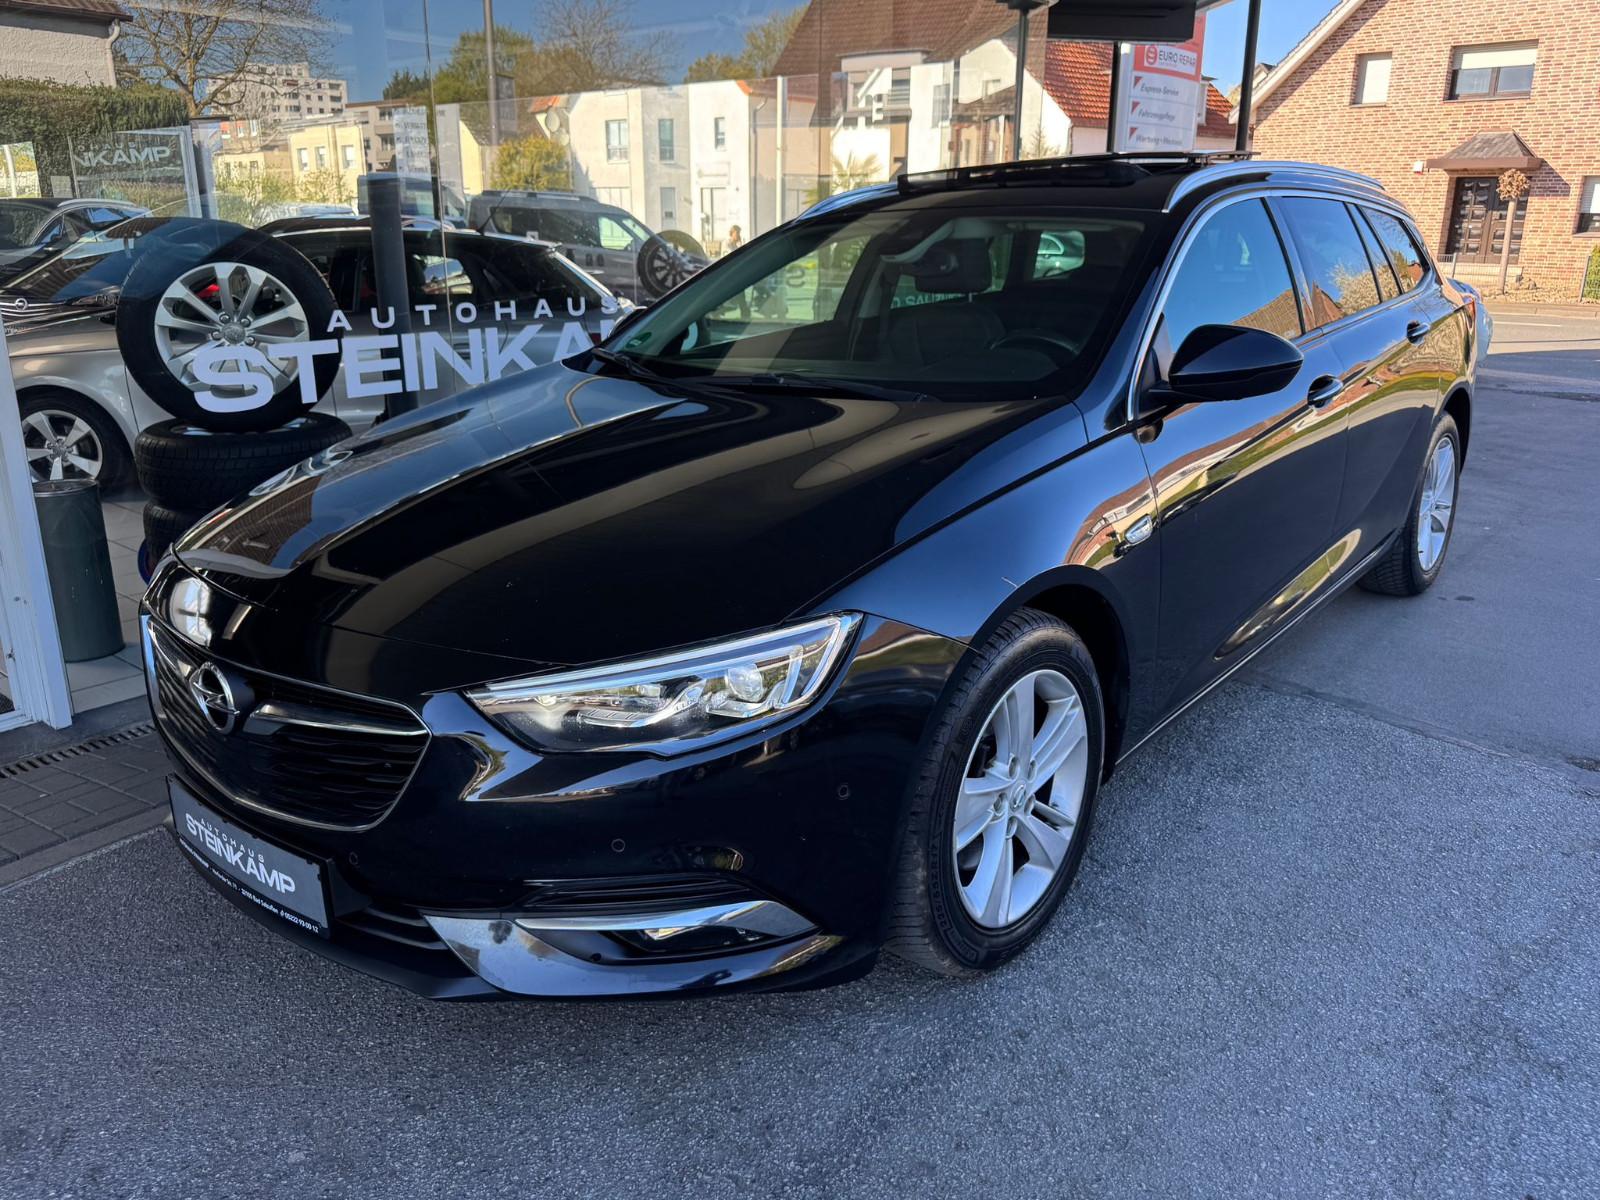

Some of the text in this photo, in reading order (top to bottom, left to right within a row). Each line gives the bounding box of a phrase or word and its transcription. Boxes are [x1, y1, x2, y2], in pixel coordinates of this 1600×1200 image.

[1159, 50, 1178, 63] EURO
[326, 296, 618, 332] AUTOHAUS
[185, 813, 296, 894] STEINKAMP
[201, 818, 265, 863] AUTOHAUS
